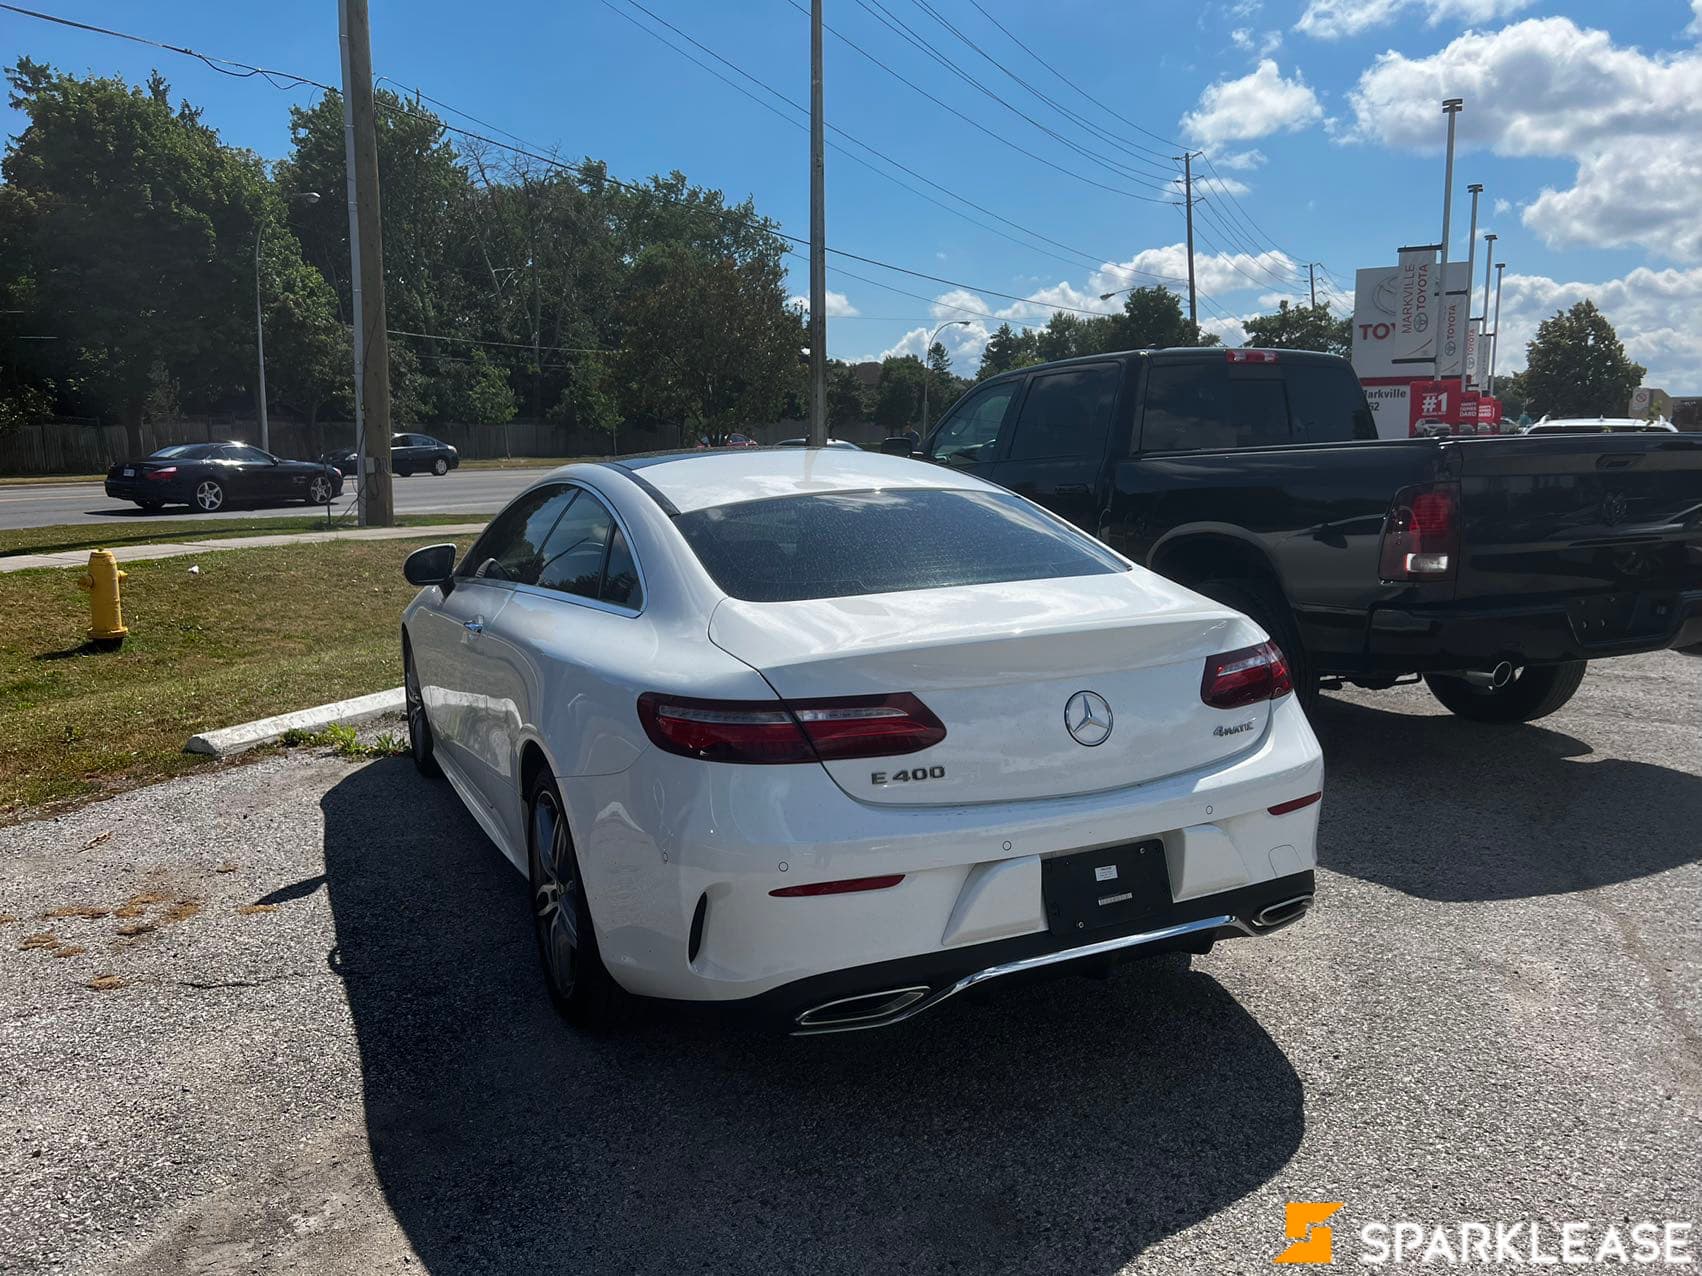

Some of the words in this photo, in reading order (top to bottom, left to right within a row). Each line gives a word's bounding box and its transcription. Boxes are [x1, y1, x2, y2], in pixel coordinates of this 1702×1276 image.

[1401, 263, 1415, 334] MARKVILLE
[1416, 263, 1429, 312] TOYOTA
[1447, 304, 1456, 340] TOYOTA
[1422, 392, 1448, 413] #1
[871, 771, 888, 785] E
[892, 766, 946, 783] 400
